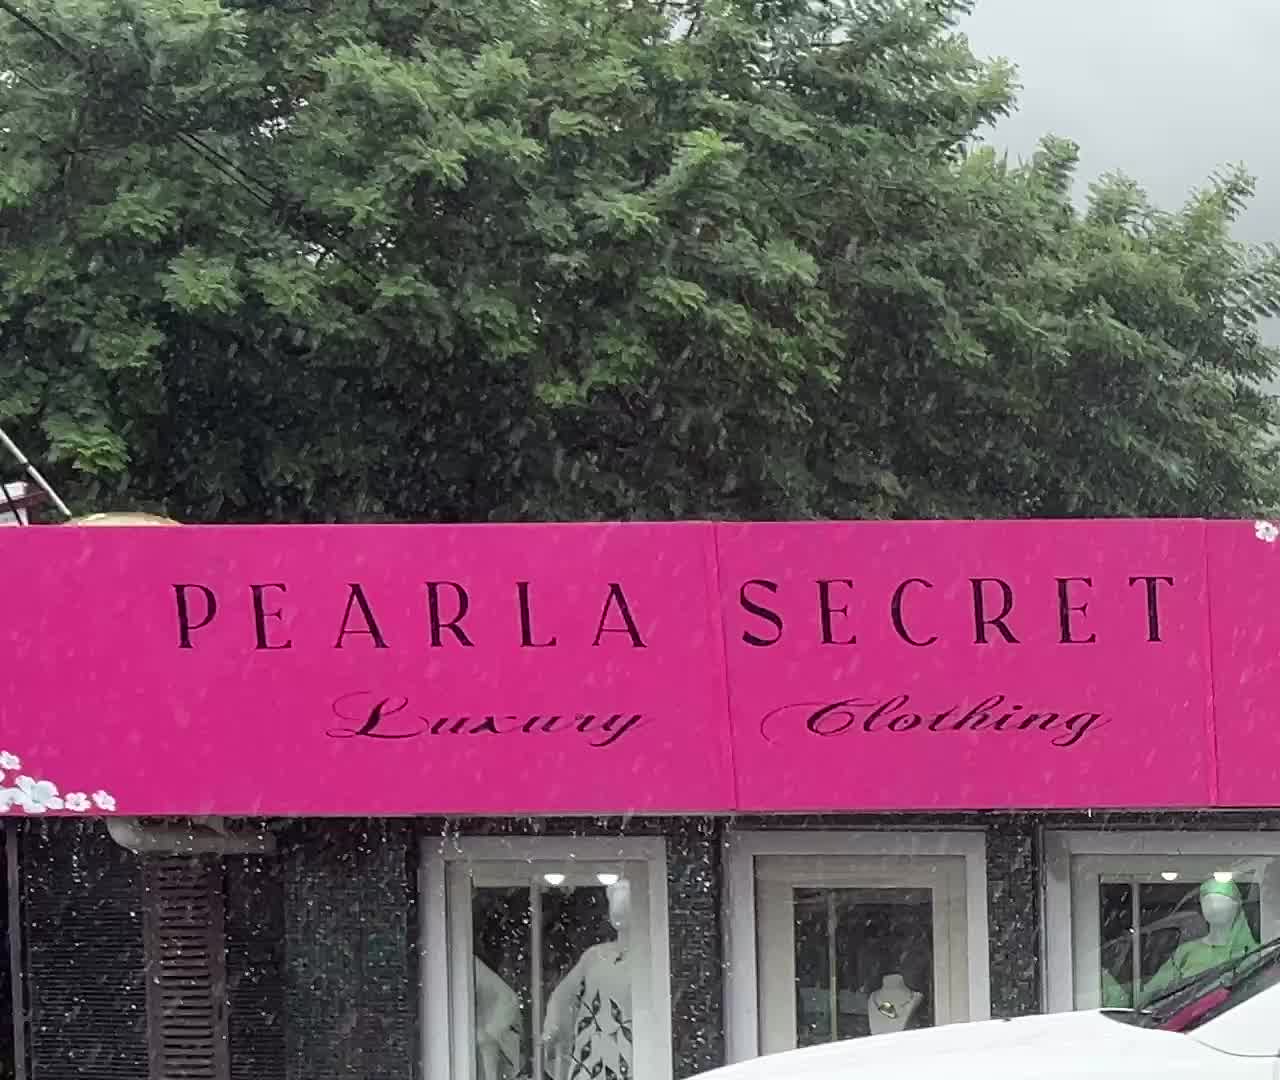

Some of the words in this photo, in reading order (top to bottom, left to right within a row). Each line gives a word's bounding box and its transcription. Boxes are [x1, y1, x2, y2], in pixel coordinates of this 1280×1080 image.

[171, 580, 648, 650] PEARLA
[738, 576, 1175, 648] SECRET
[325, 690, 656, 748] Luxury
[760, 694, 1112, 748] Clothing
